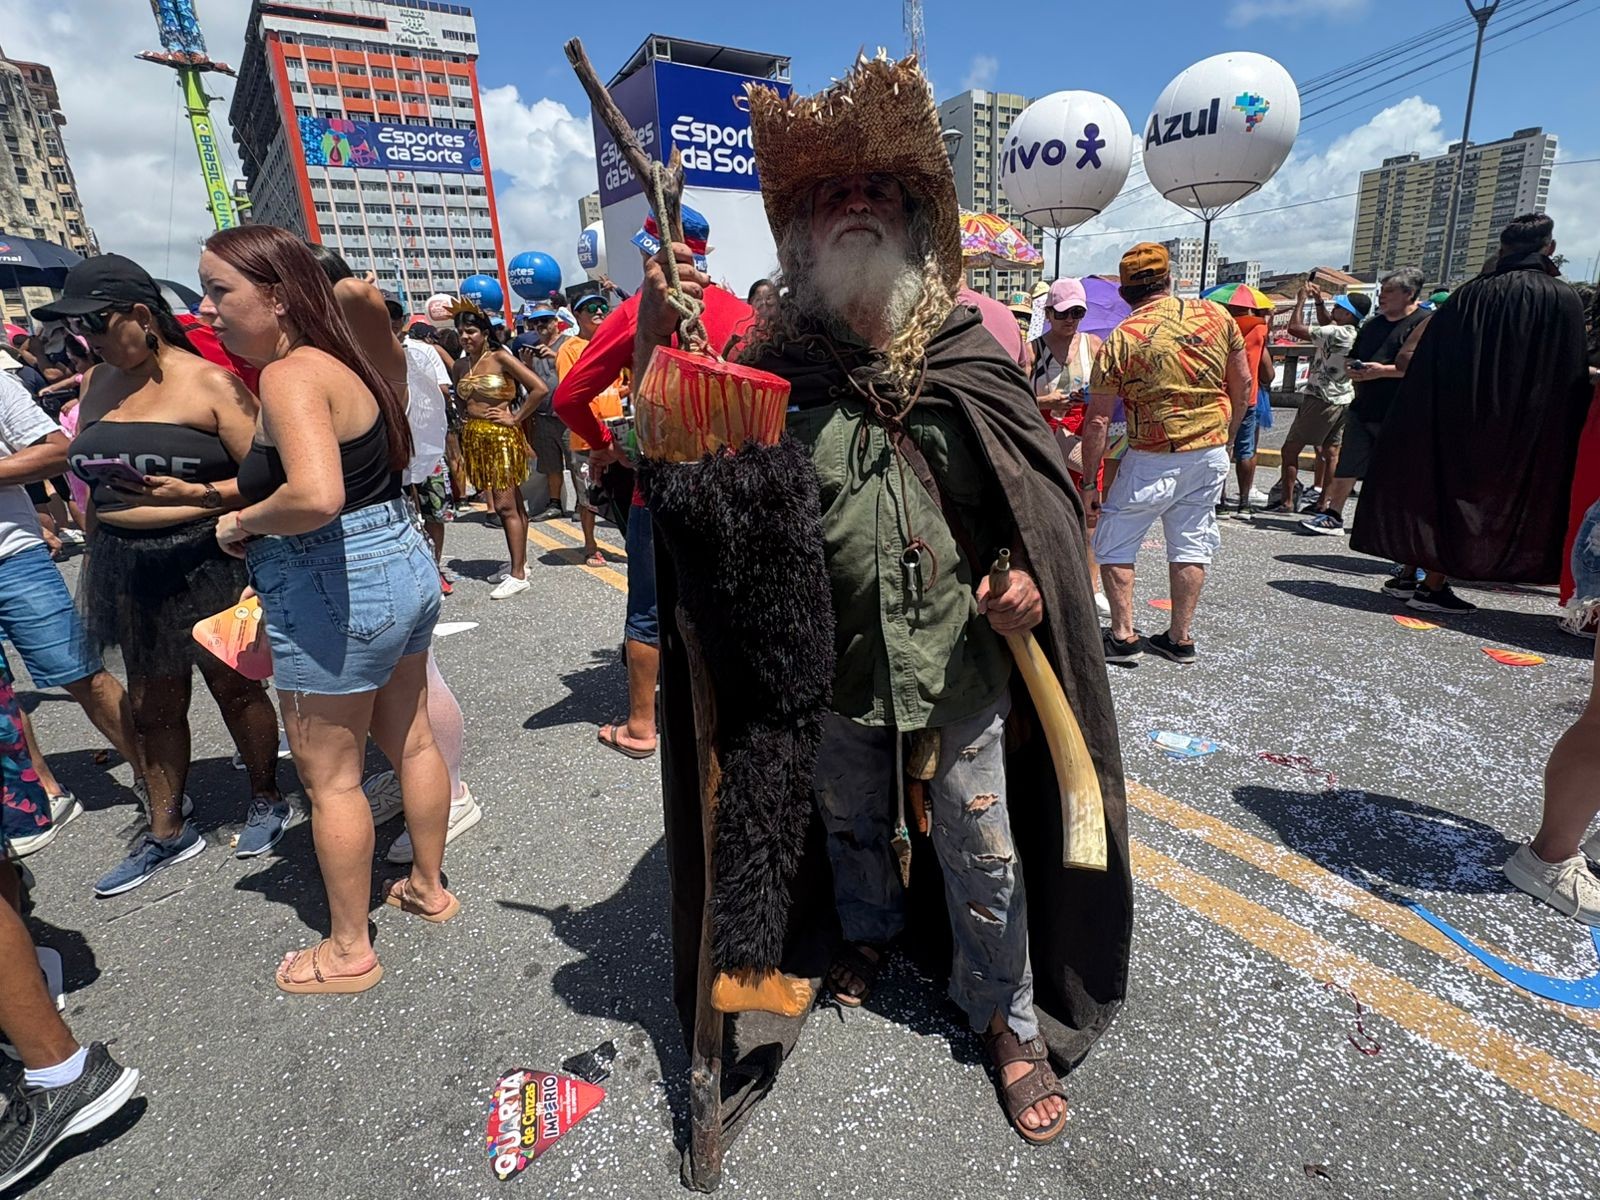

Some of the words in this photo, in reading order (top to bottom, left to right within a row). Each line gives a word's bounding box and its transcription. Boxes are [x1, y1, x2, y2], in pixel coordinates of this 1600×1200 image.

[377, 127, 465, 148] Esportes
[671, 116, 754, 150] Esport
[1145, 98, 1220, 151] Azul
[601, 122, 654, 167] Espes
[680, 145, 755, 175] daSor
[495, 1071, 524, 1175] QUARTA
[521, 1082, 537, 1126] Cinzas
[521, 1128, 536, 1145] de
